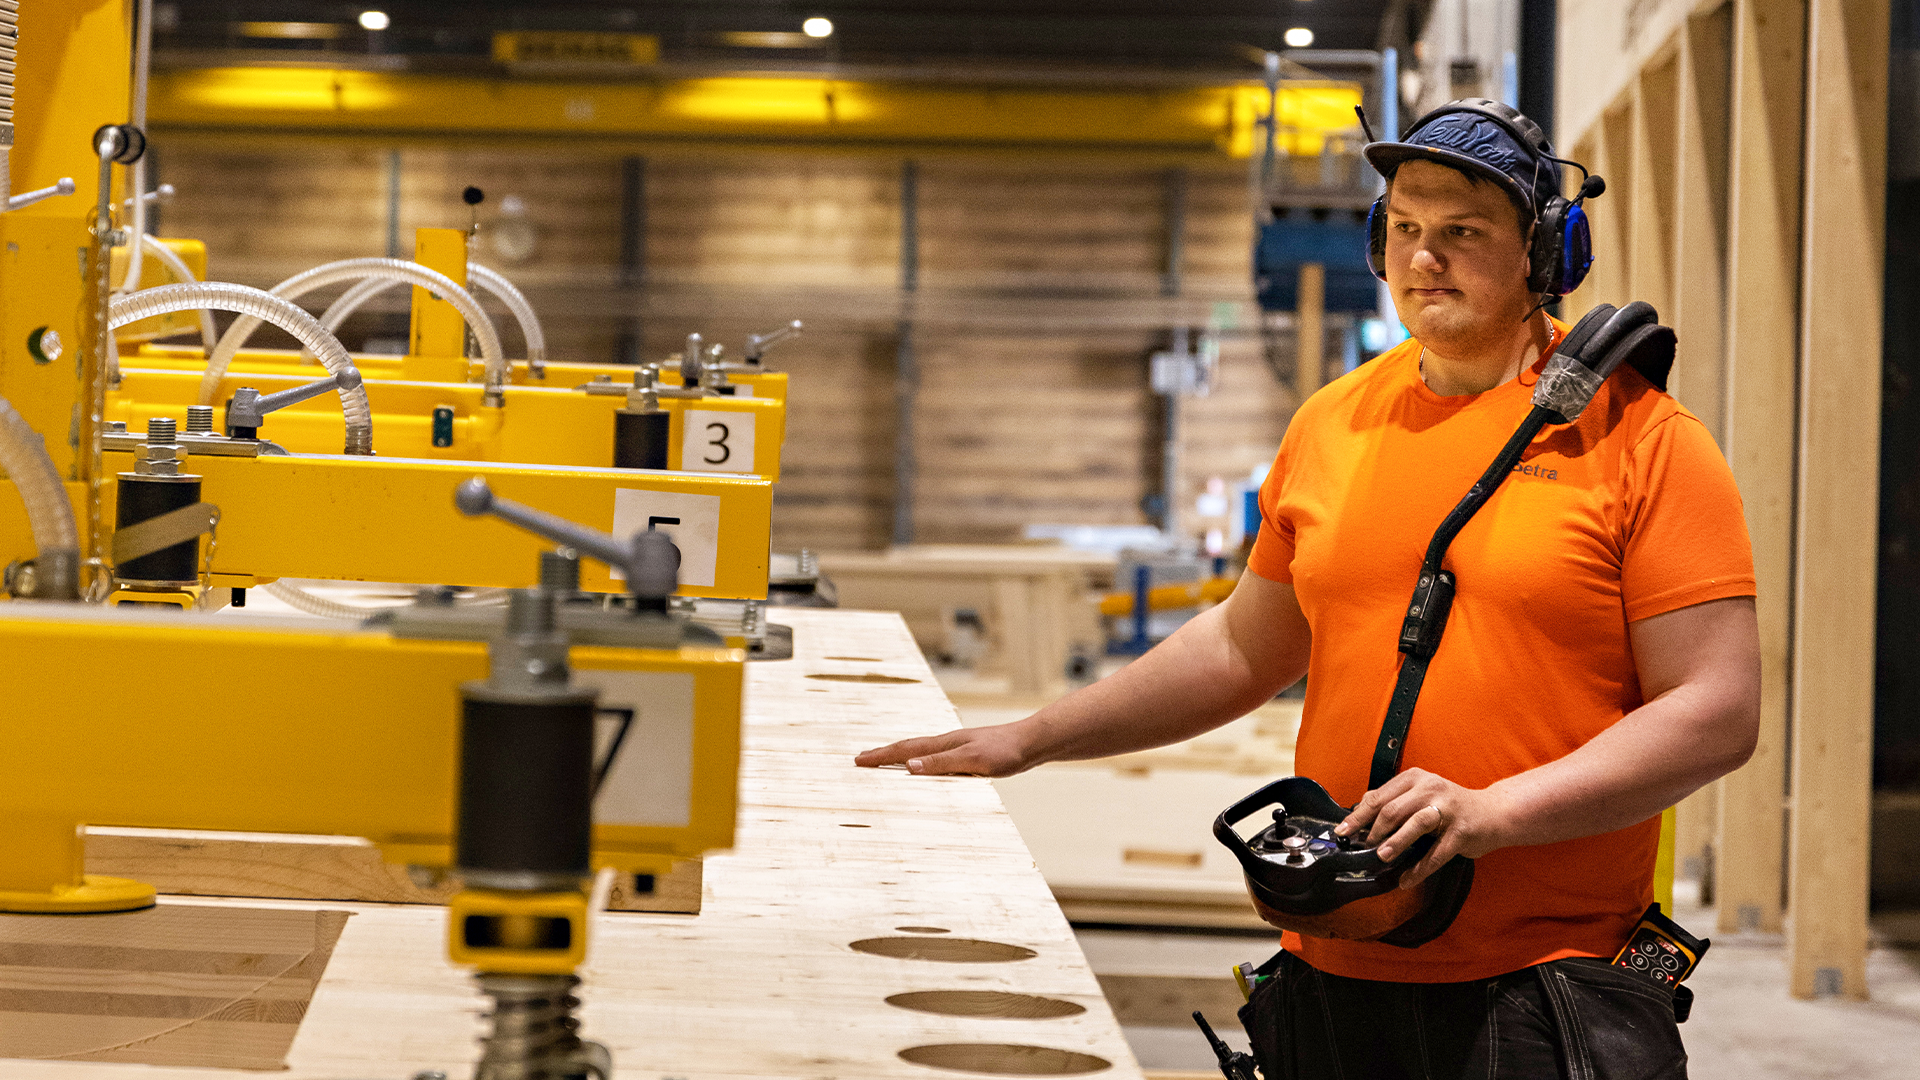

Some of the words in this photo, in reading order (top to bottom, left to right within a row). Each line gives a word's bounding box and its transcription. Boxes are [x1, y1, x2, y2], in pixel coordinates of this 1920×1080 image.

[704, 422, 730, 464] 3
[1645, 944, 1653, 952] 8
[1665, 959, 1674, 967] 7
[1656, 972, 1664, 980] 5
